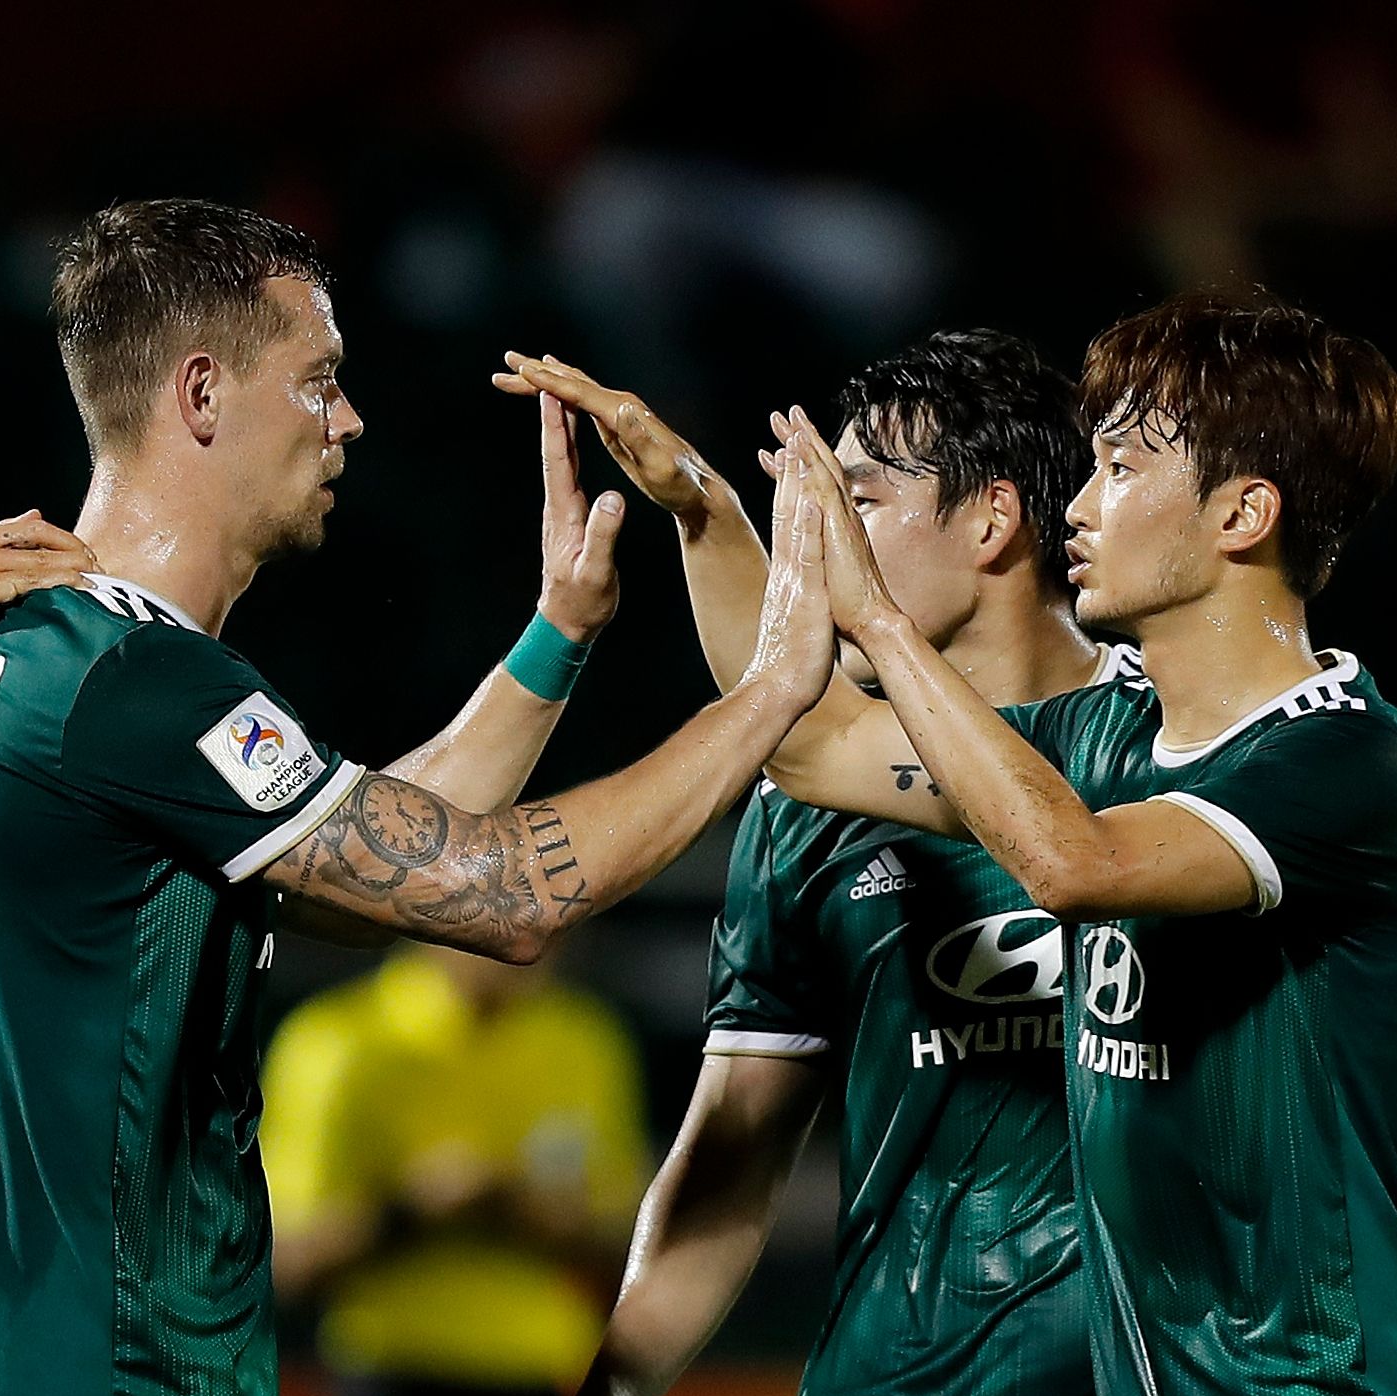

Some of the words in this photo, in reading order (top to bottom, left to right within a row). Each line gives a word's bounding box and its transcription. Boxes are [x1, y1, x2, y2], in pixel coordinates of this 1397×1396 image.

[256, 751, 312, 802] CHAMPIONS
[272, 765, 312, 802] LEAGUE
[850, 875, 917, 900] adidas
